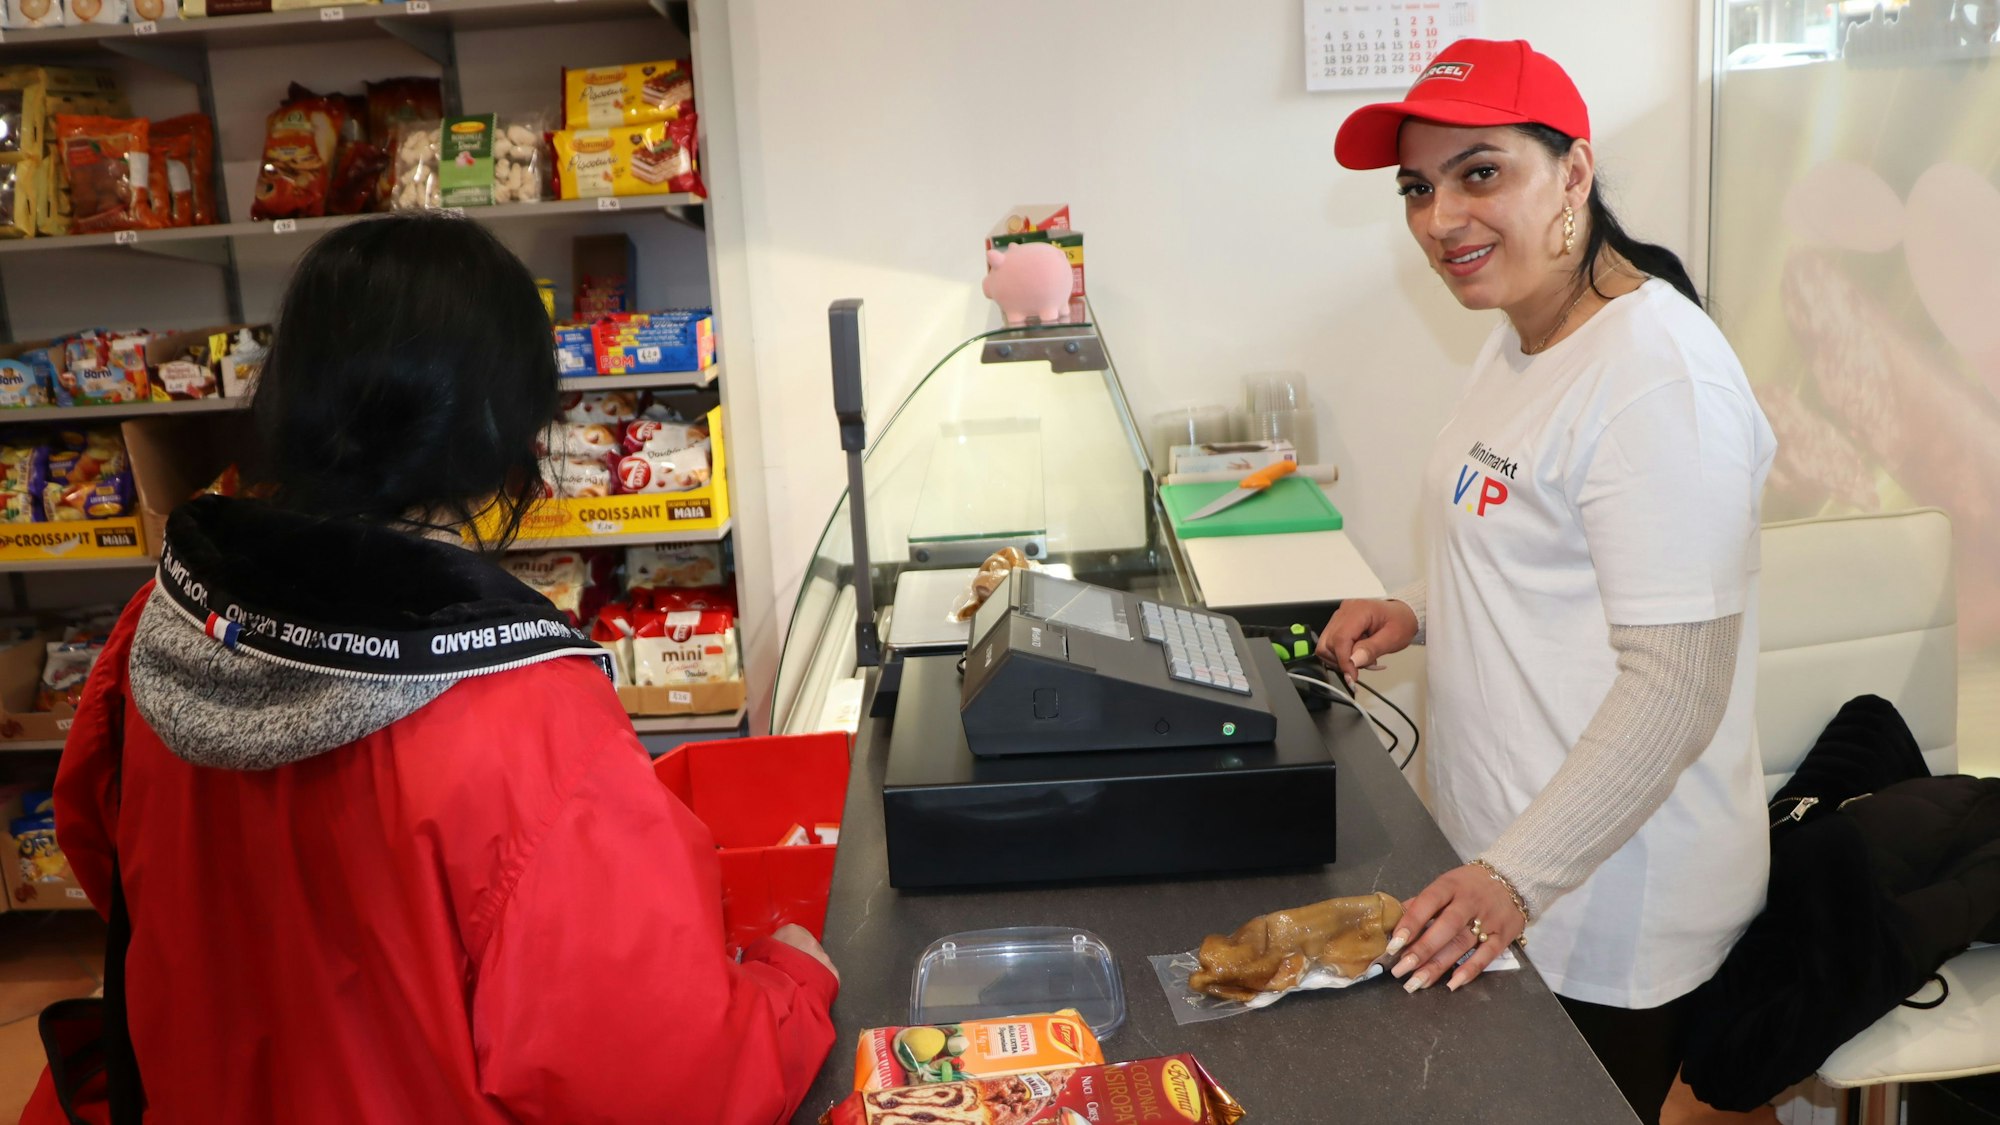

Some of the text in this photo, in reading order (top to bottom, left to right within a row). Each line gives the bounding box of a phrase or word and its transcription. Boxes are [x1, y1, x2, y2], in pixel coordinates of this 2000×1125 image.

[1394, 16, 1434, 26] 1 2 3
[1325, 28, 1437, 41] 4 5 6 7 8 9 10
[1324, 40, 1437, 53] 11 12 13 14 15 16 17
[1324, 56, 1336, 65] 18
[1341, 55, 1352, 64] 19
[1356, 55, 1369, 64] 20
[1374, 54, 1386, 63] 21
[1391, 53, 1404, 62] 22
[1409, 52, 1421, 61] 23
[1324, 64, 1421, 77] 25 26 27 28 29 30
[600, 354, 635, 369] ROM
[1468, 440, 1518, 480] Minimarkt
[579, 504, 661, 522] CROISSANT
[674, 506, 705, 519] MAIA
[102, 534, 131, 546] MAIA
[430, 627, 497, 655] BRAND
[662, 644, 702, 662] mini
[1015, 1024, 1028, 1052] POLENTA
[1130, 1065, 1161, 1121] COZONAC
